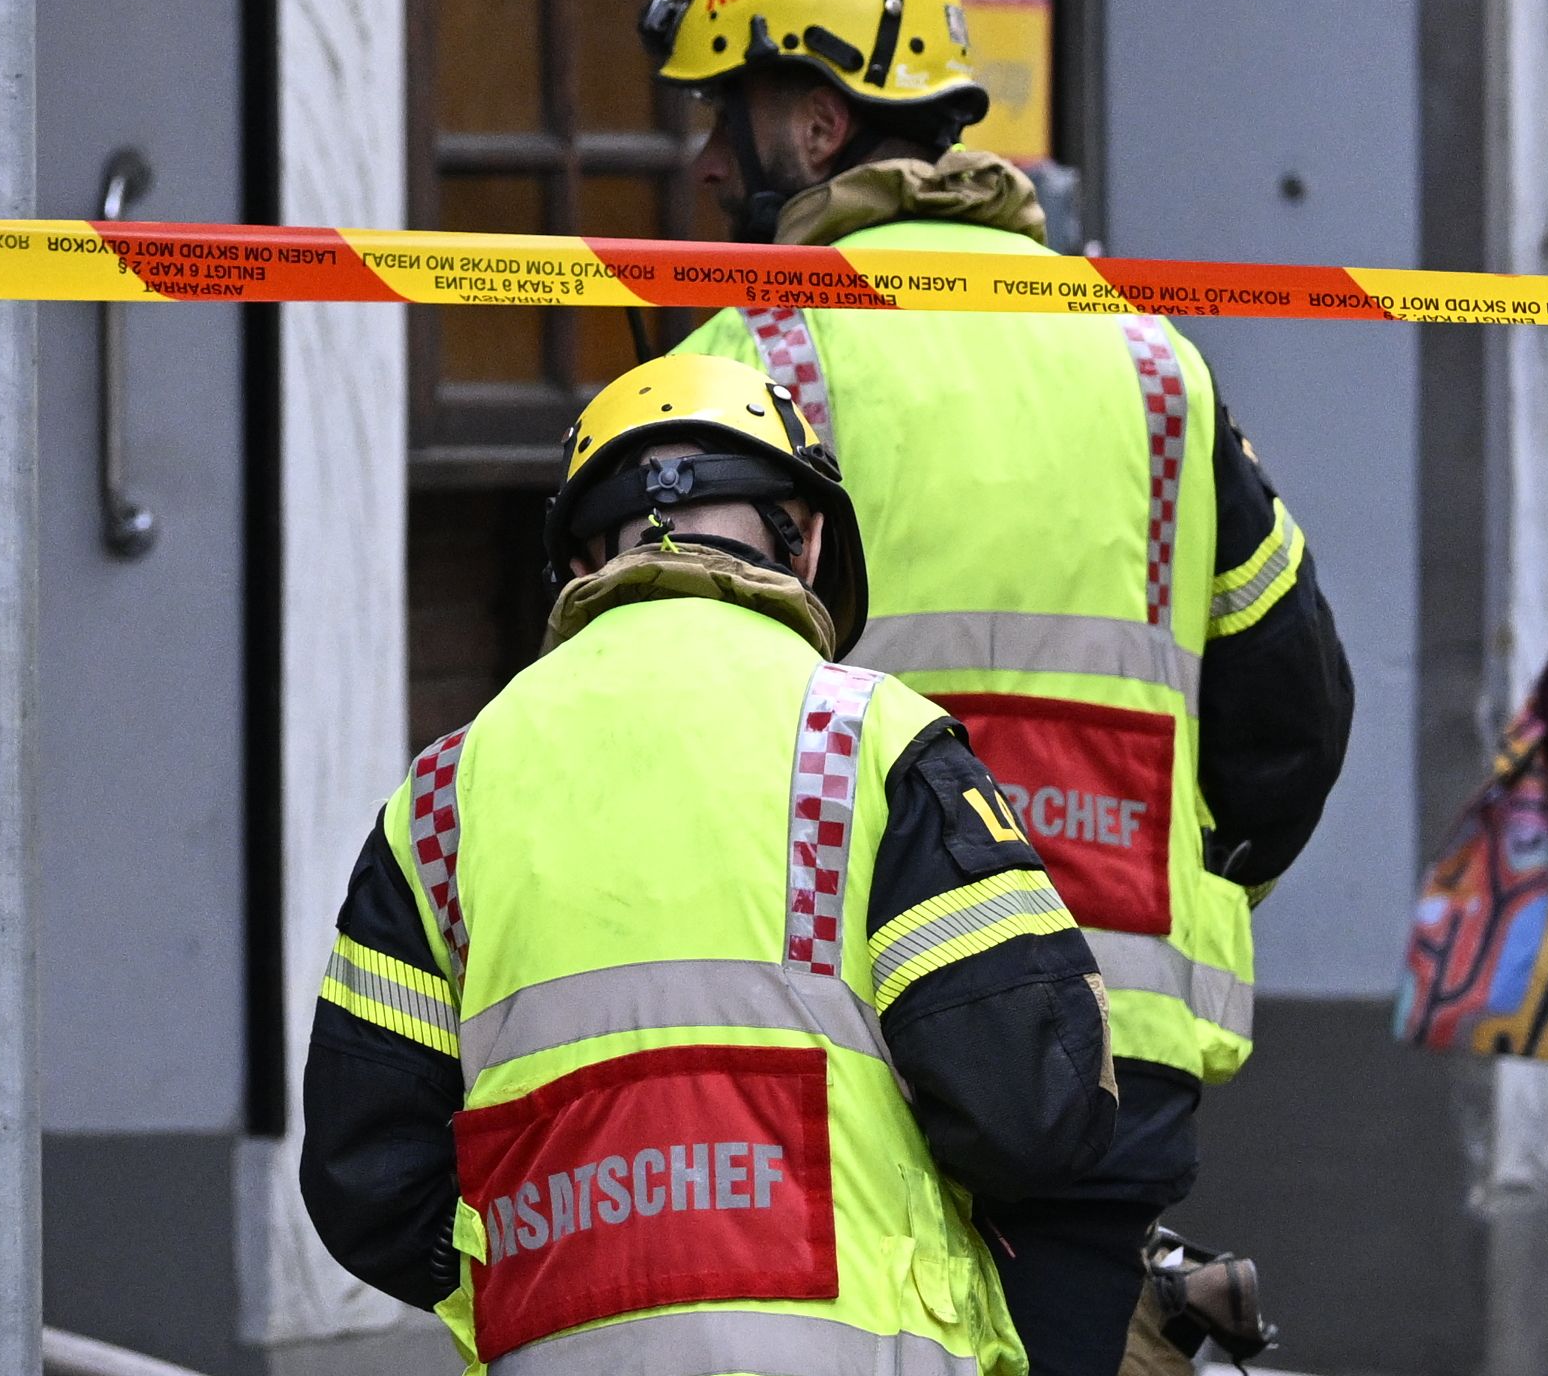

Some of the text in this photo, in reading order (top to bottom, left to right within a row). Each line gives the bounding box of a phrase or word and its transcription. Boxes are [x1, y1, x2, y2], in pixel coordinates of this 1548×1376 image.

[47, 236, 337, 265] LAGEN OM SKYDD MOT OLYCKOR
[131, 259, 141, 274] 2
[147, 259, 185, 278] KAP.
[191, 262, 200, 277] 6
[204, 264, 265, 281] ENLIGT
[673, 265, 967, 292] LAGEN OM SKYDD MOT OLYCKOR
[778, 288, 815, 304] KAP.
[821, 291, 830, 305] 6
[835, 293, 897, 307] ENLIGT
[1309, 292, 1394, 309] OLYCKOR
[1401, 296, 1440, 311] MOT
[1445, 298, 1506, 314] SKYDD
[1512, 300, 1541, 314] OM
